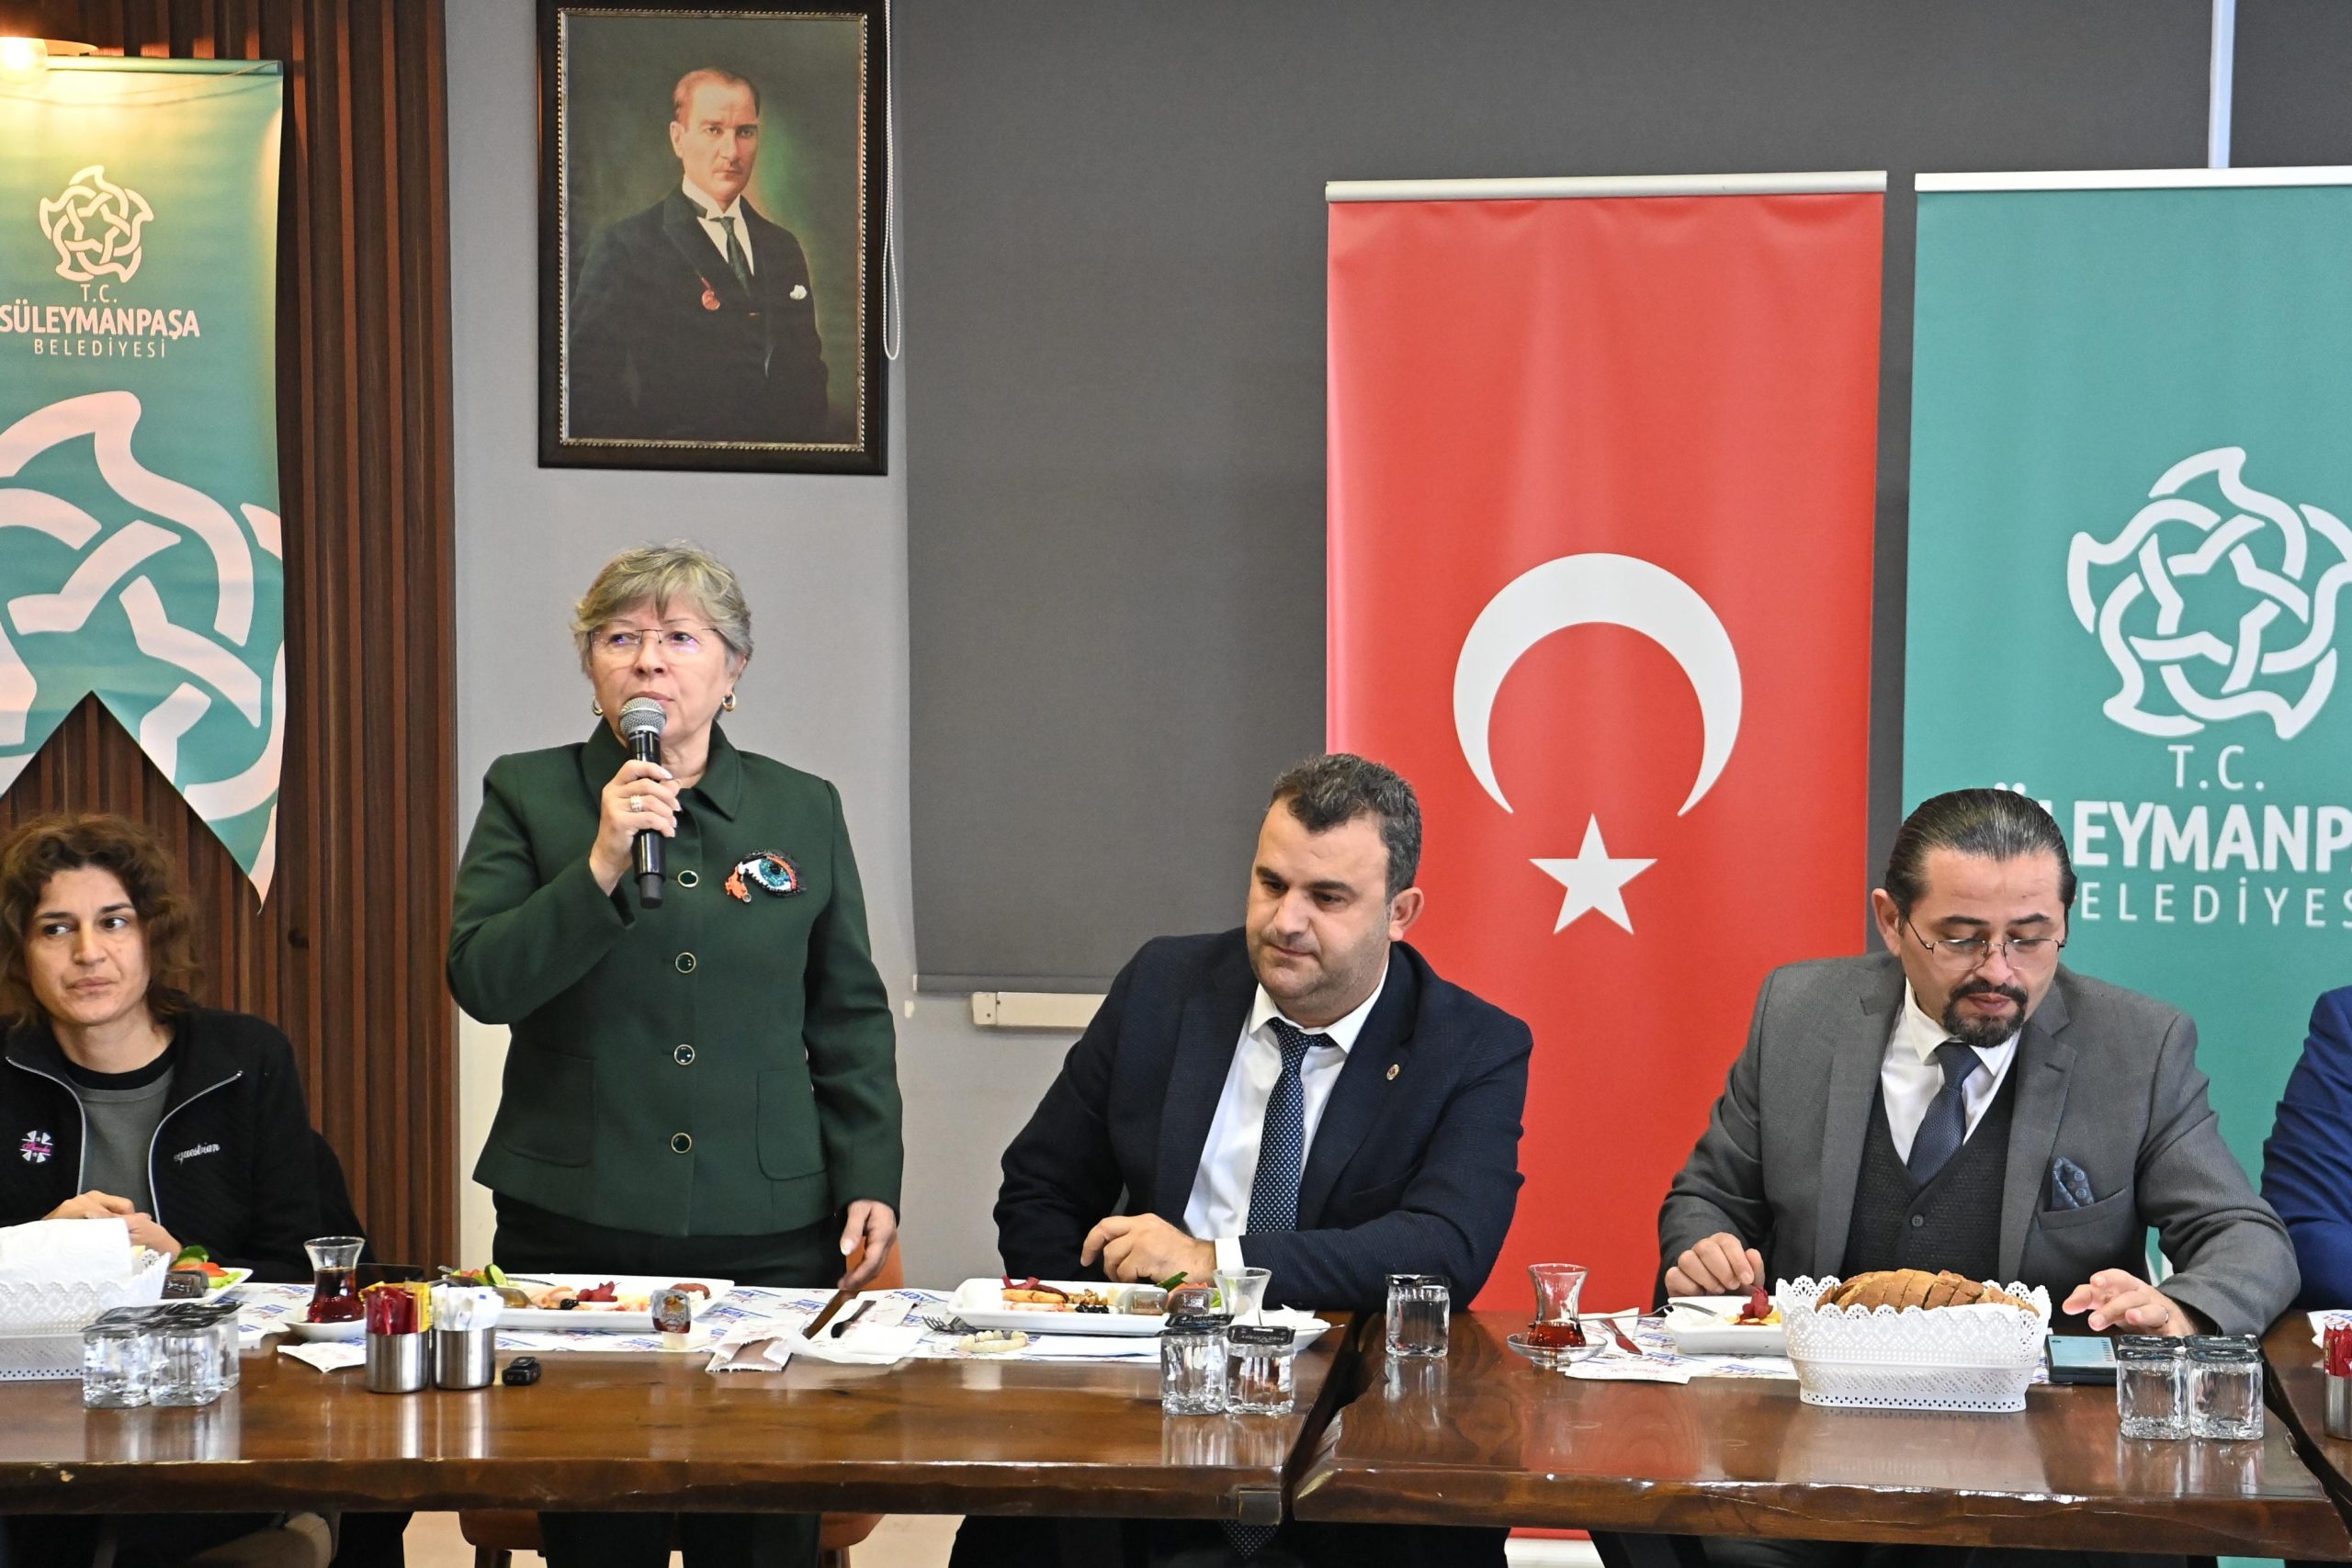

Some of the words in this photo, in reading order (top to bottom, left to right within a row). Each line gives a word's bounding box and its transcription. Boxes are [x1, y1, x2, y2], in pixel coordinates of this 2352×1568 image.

[80, 283, 119, 303] T.C.
[0, 299, 200, 340] SÜLEYMANPAŞA
[34, 336, 165, 358] BELEDİYESİ
[2166, 744, 2266, 791] T.C.
[1995, 783, 2352, 874] EYMANP
[2080, 876, 2352, 930] ELEDİYES
